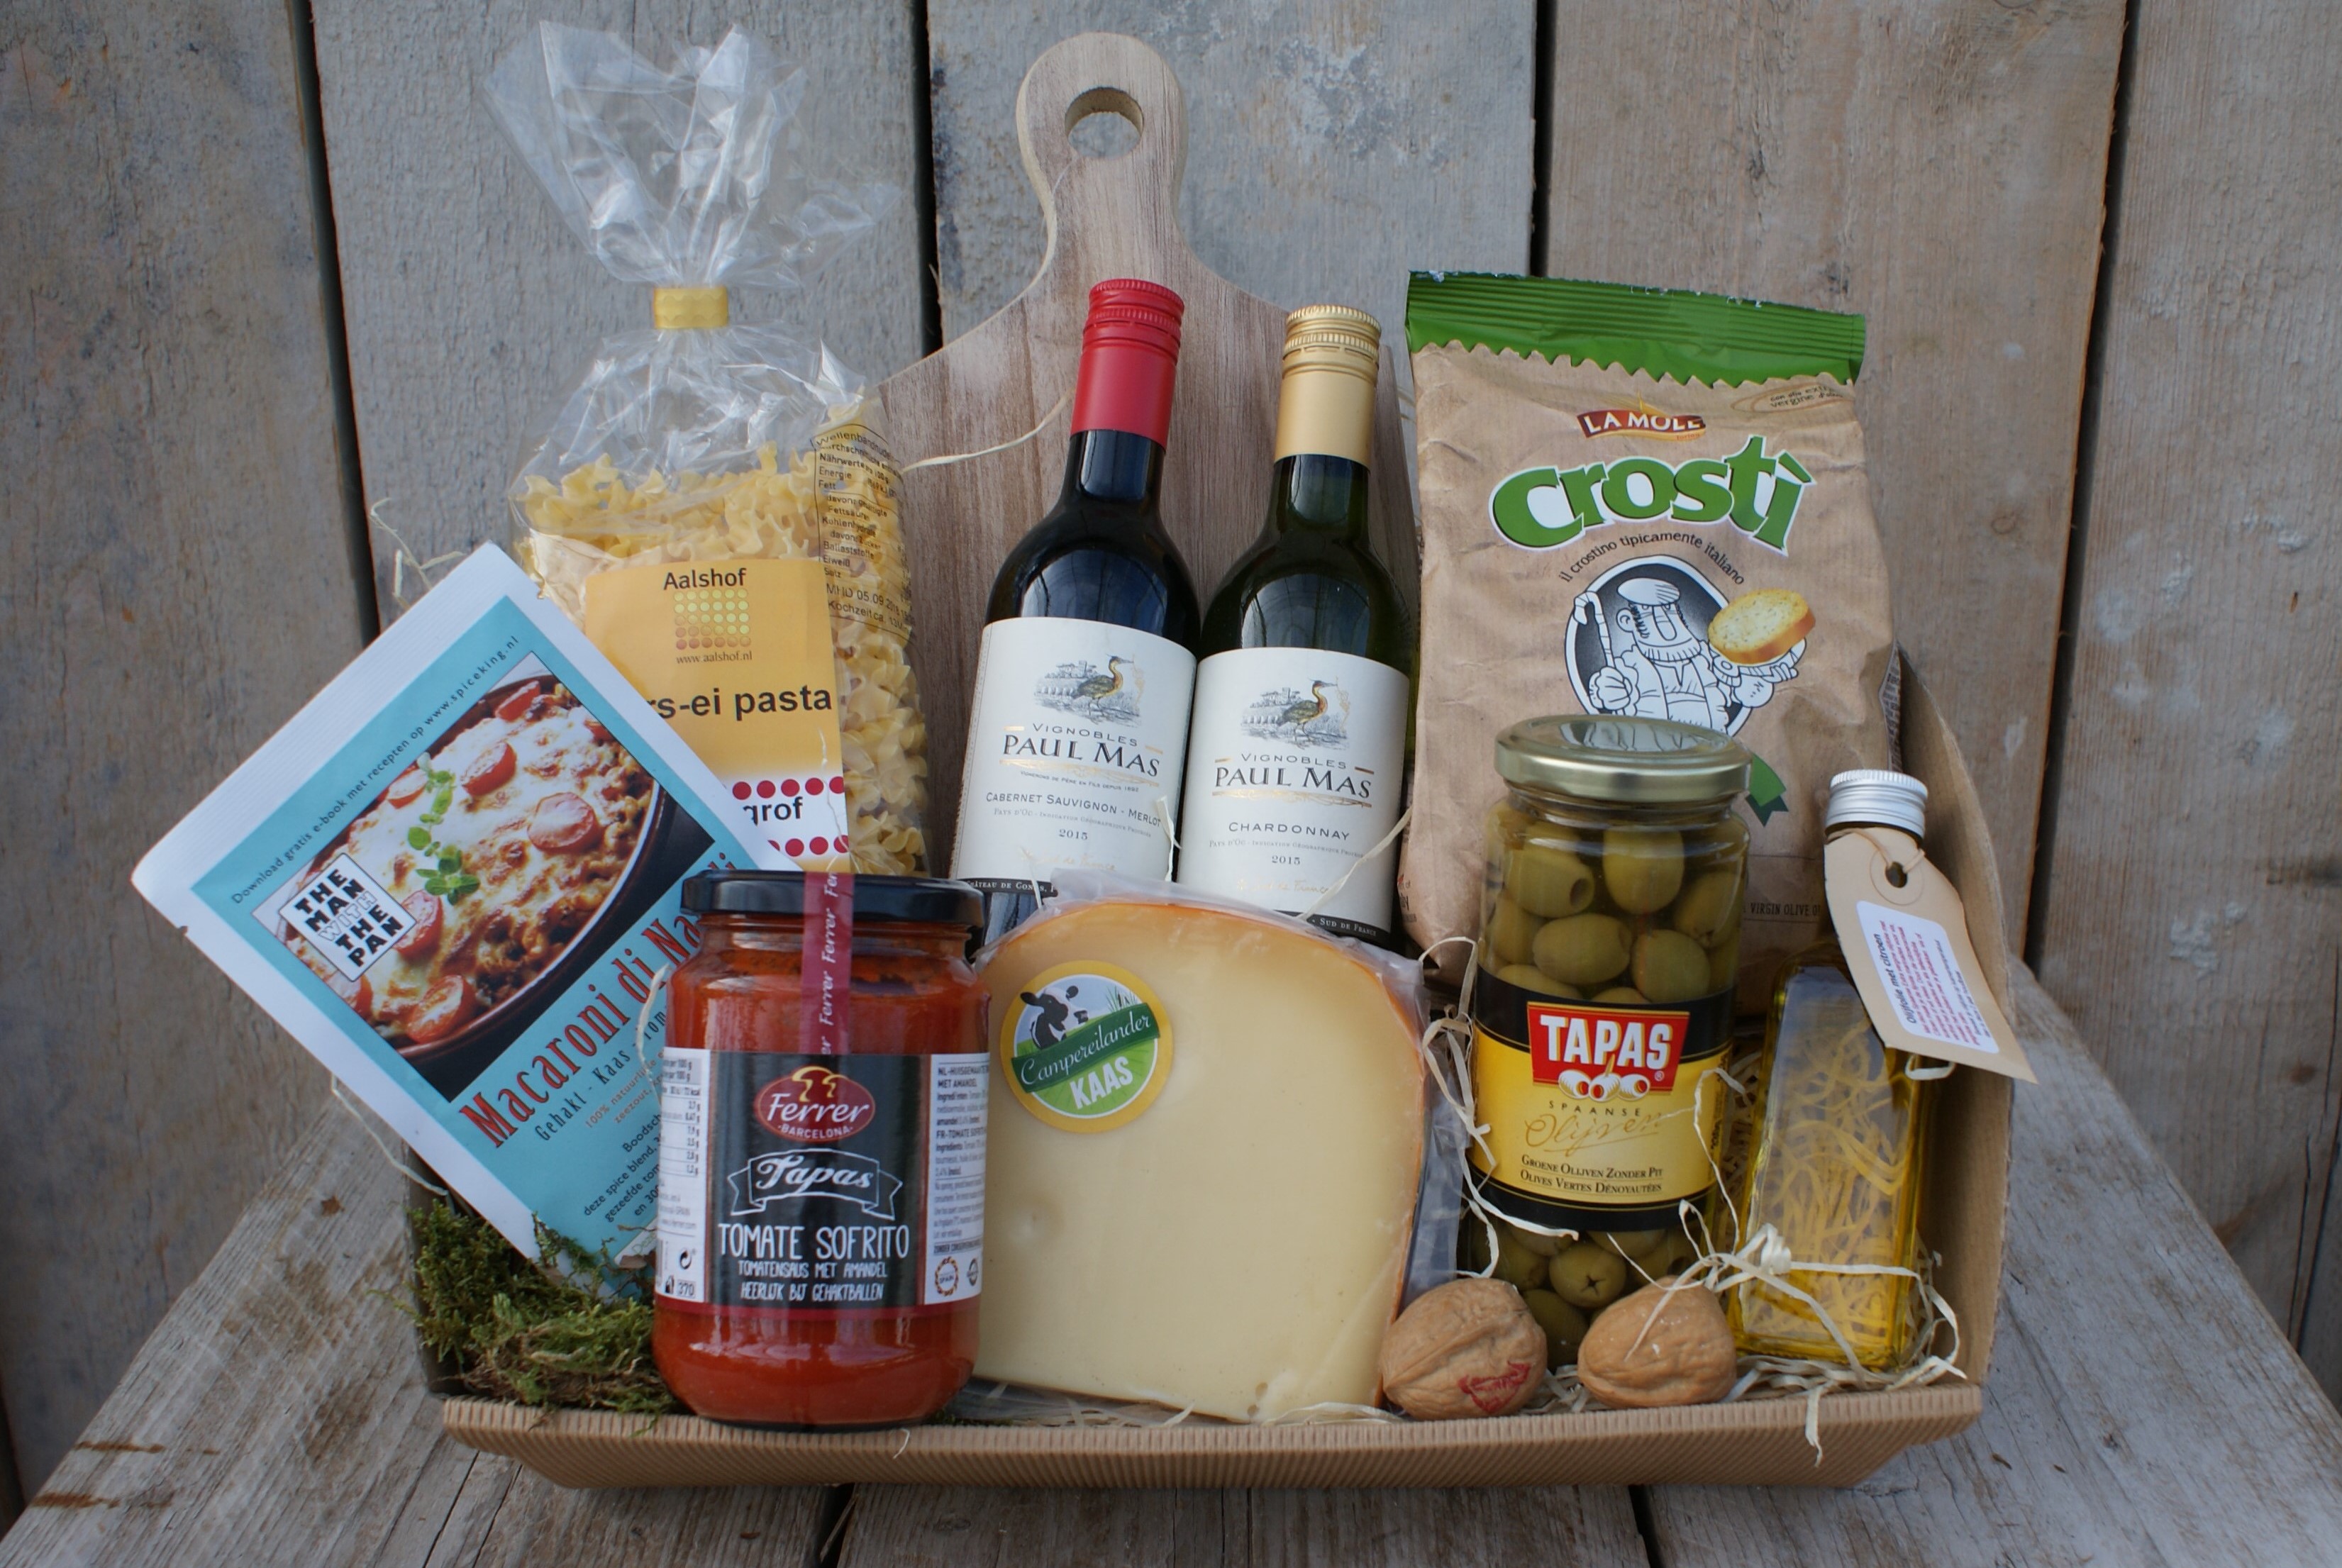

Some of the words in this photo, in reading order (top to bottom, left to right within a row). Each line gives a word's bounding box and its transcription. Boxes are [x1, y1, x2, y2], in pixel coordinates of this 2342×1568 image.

[1584, 411, 1623, 434] LA
[818, 479, 836, 490] Fett
[819, 466, 853, 481] Energie
[1558, 572, 1573, 583] il
[1570, 540, 1618, 574] crostino
[1619, 532, 1703, 549] tipicamente
[1704, 542, 1745, 586] italiano
[664, 568, 747, 590] Aalshof
[828, 600, 872, 618] Kochzeit
[676, 651, 753, 665] www.aalshof.nl
[735, 684, 832, 722] pasta
[1032, 722, 1138, 747] VIGNOBLES
[231, 857, 284, 904] Download
[284, 832, 312, 861] gratis
[313, 798, 347, 832] e-book
[346, 780, 367, 800] met
[367, 740, 410, 780] recepten
[411, 725, 425, 740] op
[424, 635, 519, 725] www.spiceking.nl
[1002, 734, 1084, 761] PAUL
[1092, 741, 1161, 778] MAS
[1240, 752, 1347, 769] VIGNOBLES
[1215, 766, 1292, 787] PAUL
[1302, 767, 1372, 799] MAS
[986, 791, 1042, 804] CABERNET
[1045, 793, 1118, 815] SAUVIGNON
[1128, 807, 1162, 828] MERLOT
[1058, 828, 1089, 841] 2015
[1228, 822, 1350, 841] CHARDONNAY
[1271, 855, 1302, 866] 2015
[294, 869, 348, 914] THE
[305, 879, 365, 933] MAN
[318, 890, 378, 942] WITH
[1750, 903, 1781, 916] VIRGIN
[1784, 903, 1809, 916] OLIVE
[334, 904, 389, 951] THE
[348, 916, 404, 967] PAN
[821, 907, 836, 964] Ferrer
[1319, 918, 1338, 928] SUD
[1341, 922, 1351, 930] DE
[1353, 923, 1377, 937] FRANCE
[1873, 933, 1892, 967] citroen
[1885, 968, 1899, 987] met
[818, 970, 834, 1026] Ferrer
[1894, 989, 1916, 1023] Olijfolie
[459, 983, 631, 1148] Macaroni
[611, 947, 666, 1004] di
[1020, 1011, 1151, 1085] Campereilander
[1539, 1014, 1673, 1070] TAPAS
[534, 1091, 587, 1142] Gehakt
[592, 1050, 631, 1085] Kaas
[1070, 1056, 1133, 1110] KAAS
[585, 1103, 610, 1128] 100%
[767, 1093, 870, 1123] Ferrer
[1549, 1100, 1641, 1117] SPAANSE
[1524, 1112, 1662, 1157] Olijven
[755, 1155, 875, 1196] Tapas
[1520, 1169, 1553, 1186] OLIVES
[1555, 1177, 1592, 1192] VERTES
[1596, 1182, 1663, 1195] DÉNOYAUTÉES
[1521, 1154, 1559, 1172] GROENE
[1560, 1163, 1603, 1178] OLIJVEN
[1606, 1167, 1646, 1179] ZONDER
[1648, 1167, 1663, 1178] PIT
[584, 1194, 606, 1216] deze
[606, 1172, 630, 1196] spice
[604, 1182, 644, 1223] gezeefde
[634, 1203, 647, 1217] en
[718, 1222, 806, 1260] TOMATE
[816, 1224, 910, 1260] SOFRITO
[738, 1260, 809, 1278] TOMATENSAUS
[815, 1262, 838, 1278] MET
[843, 1261, 888, 1278] AMANDEL
[677, 1282, 695, 1296] 370
[740, 1281, 785, 1301] HEERLIJK
[789, 1282, 809, 1301] BIJ
[811, 1282, 884, 1301] GEHAKTBALLEN
